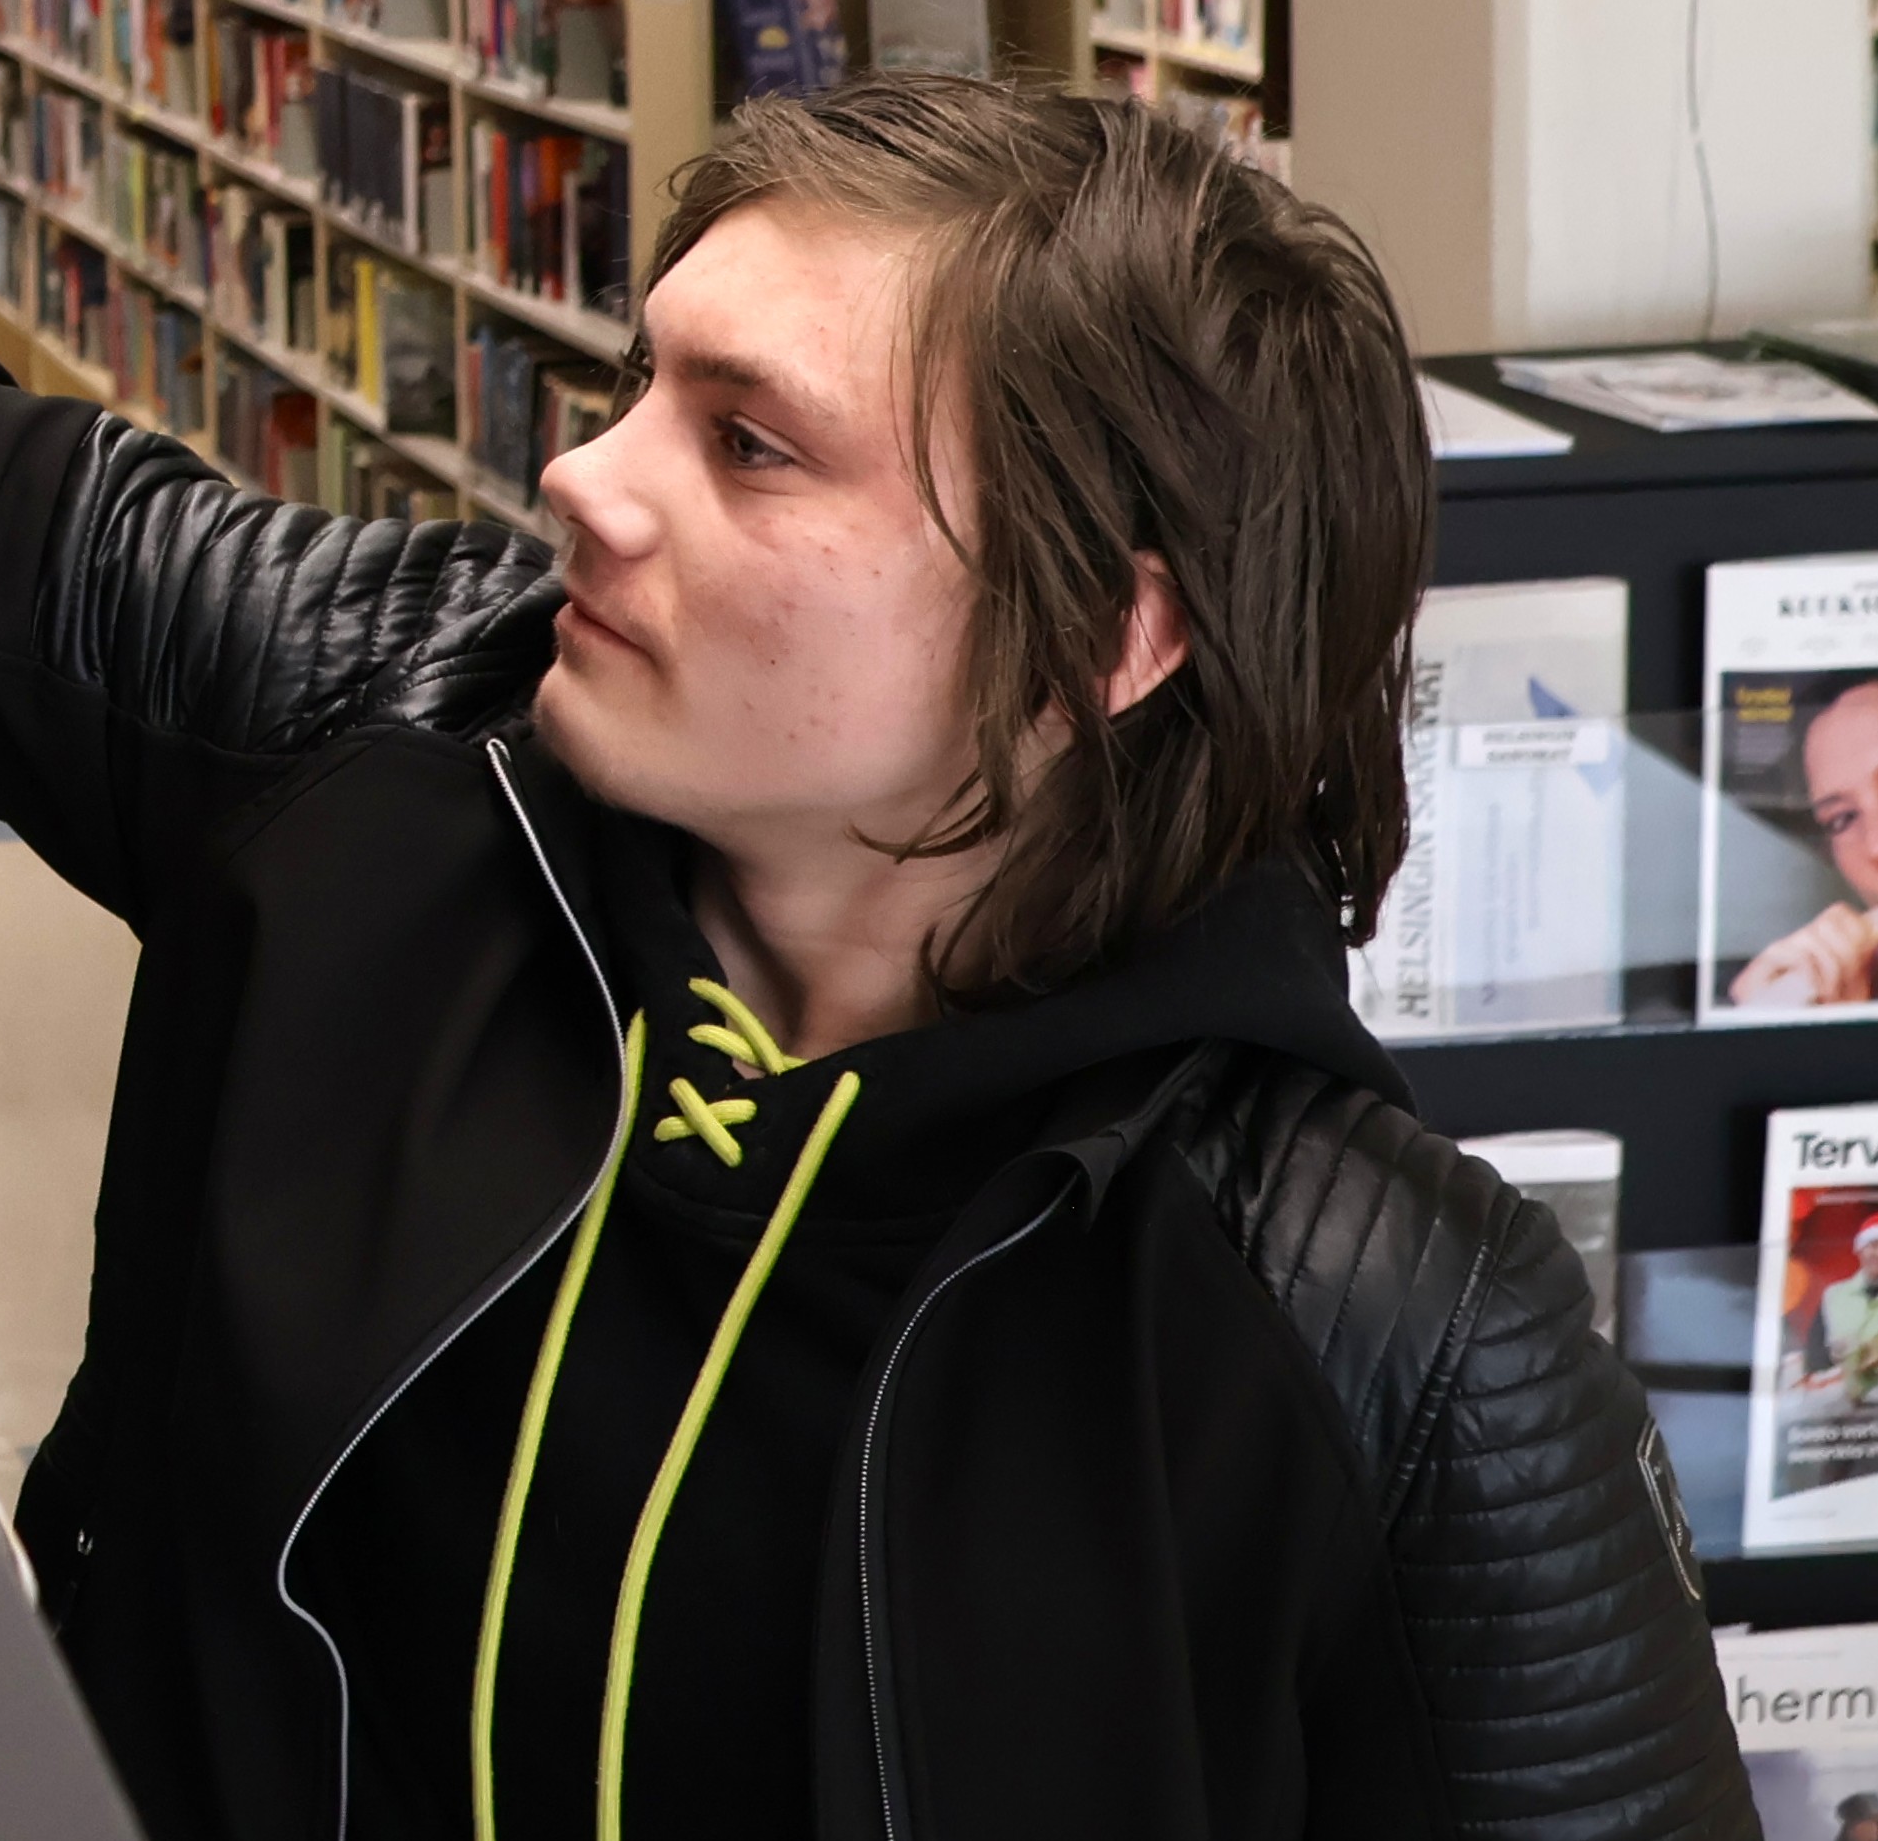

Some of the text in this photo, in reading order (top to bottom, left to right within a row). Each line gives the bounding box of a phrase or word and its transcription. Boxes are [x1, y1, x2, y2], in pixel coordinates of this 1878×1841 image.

[1396, 830, 1435, 1019] HELSINGIN
[1792, 1130, 1878, 1170] Terv
[1736, 1674, 1875, 1725] herm
